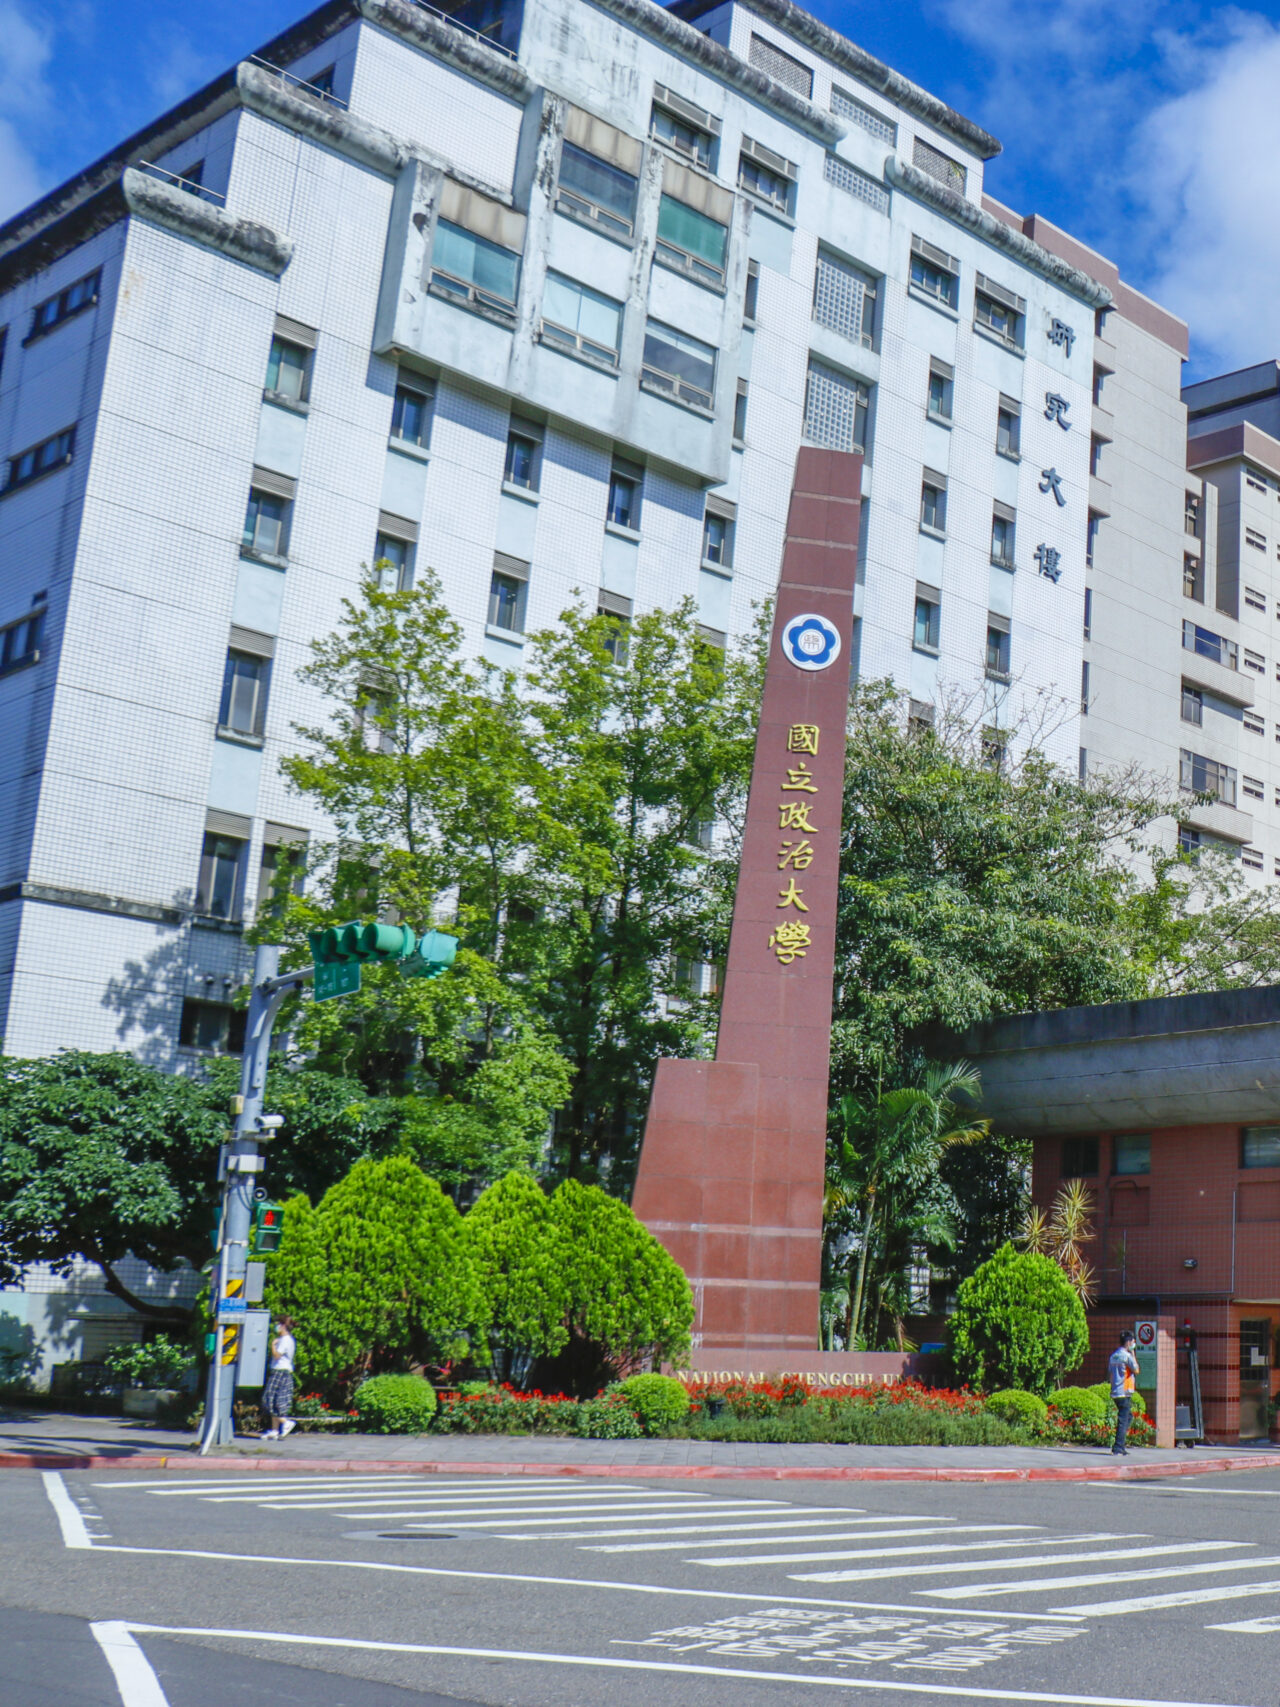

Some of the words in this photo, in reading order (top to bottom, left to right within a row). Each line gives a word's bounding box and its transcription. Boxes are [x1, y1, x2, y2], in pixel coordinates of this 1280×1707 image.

[1034, 317, 1076, 584] 研究大樓
[768, 724, 820, 965] 國立政治大學
[890, 1625, 1090, 1672] 1600-1700
